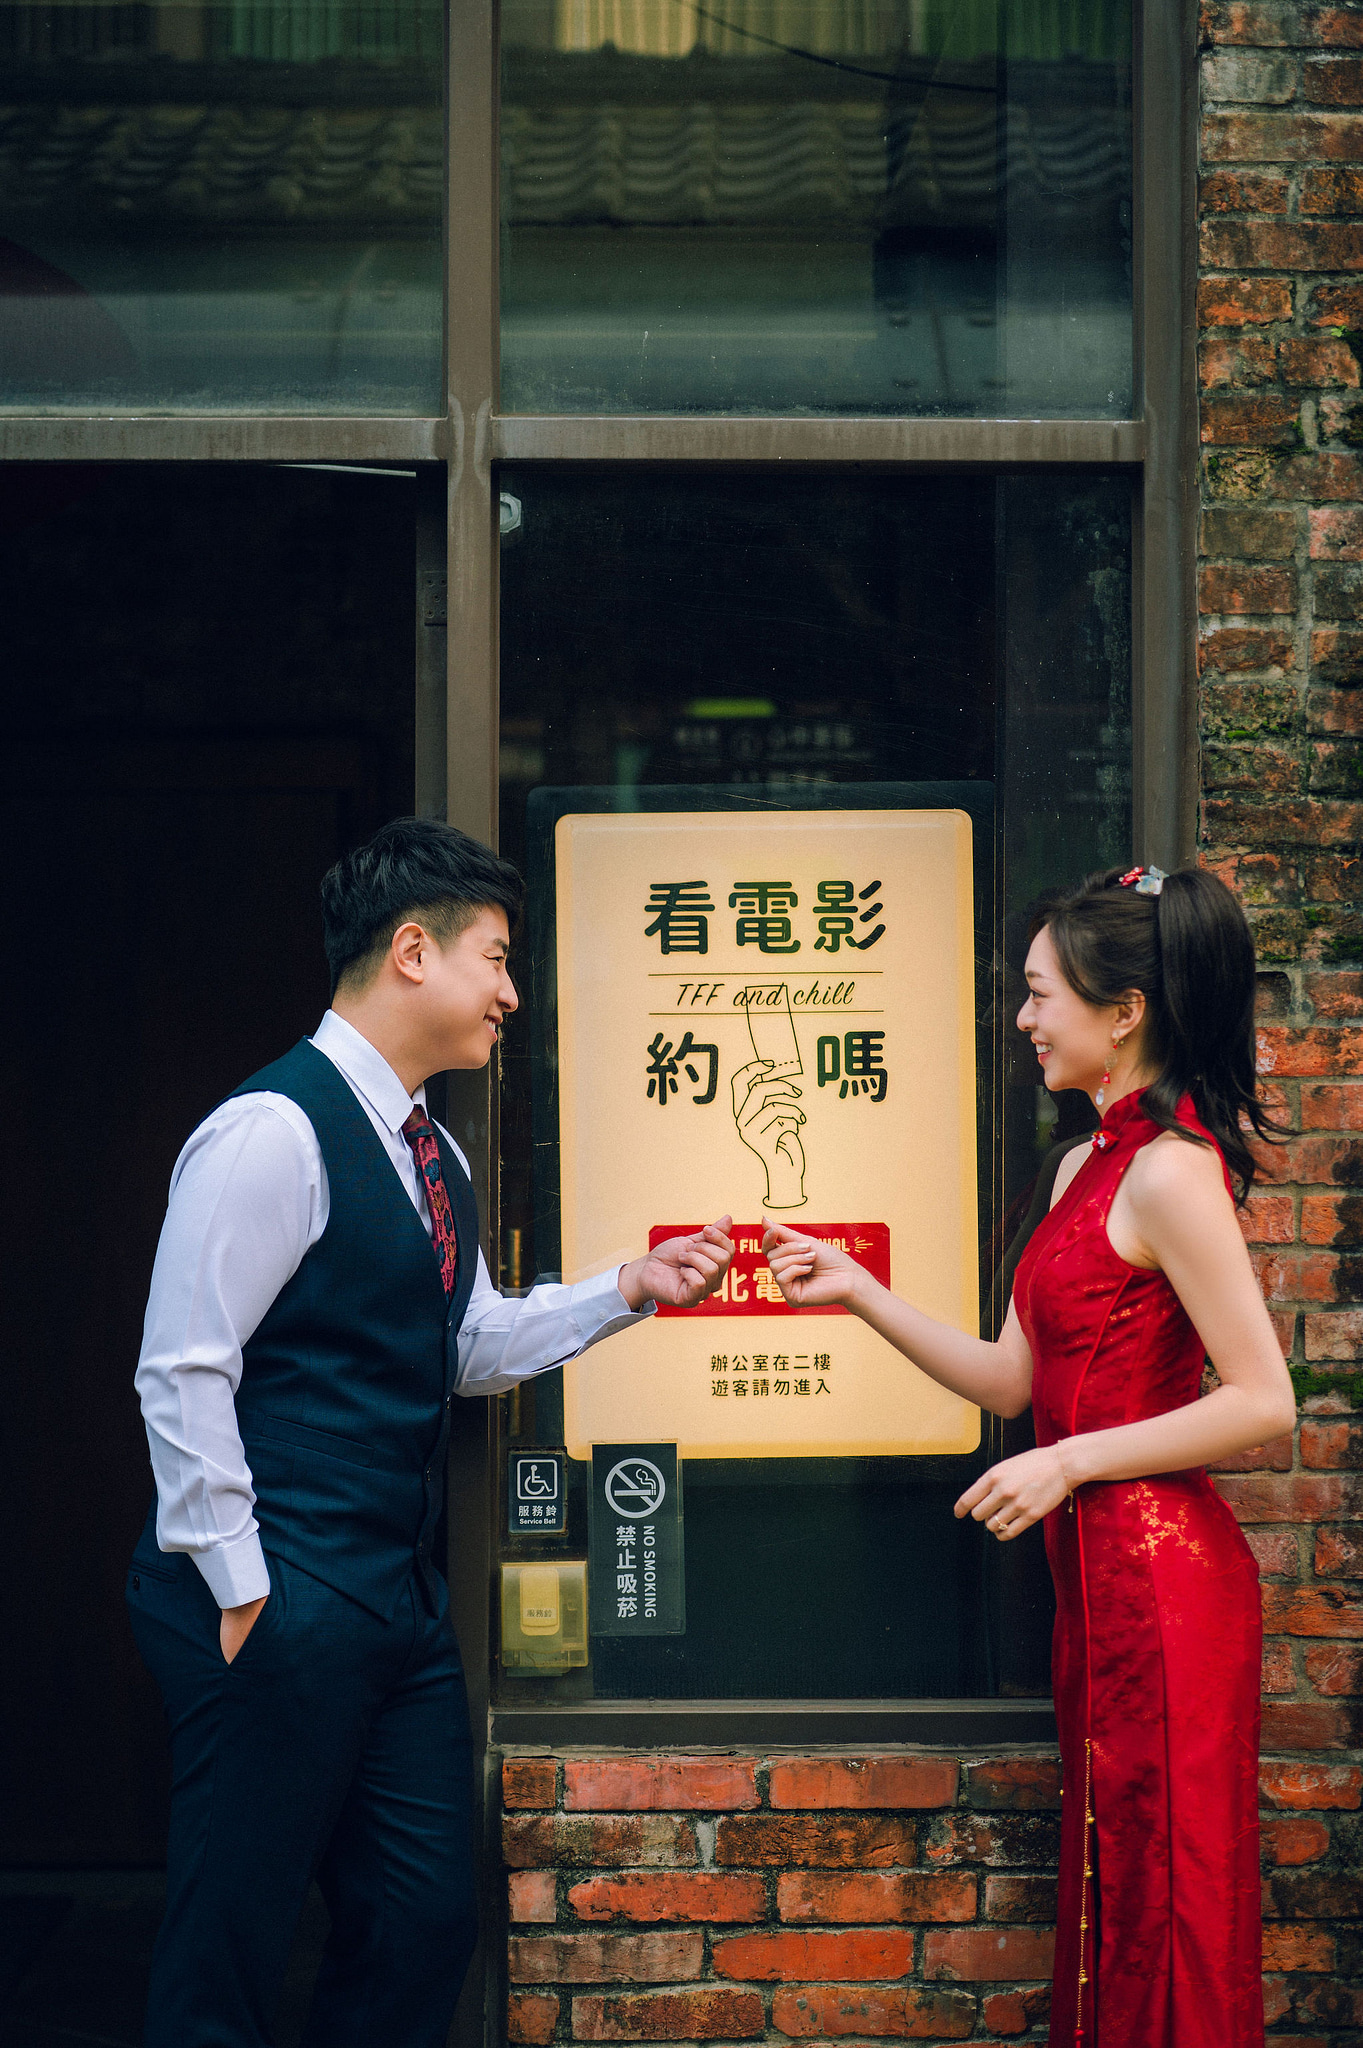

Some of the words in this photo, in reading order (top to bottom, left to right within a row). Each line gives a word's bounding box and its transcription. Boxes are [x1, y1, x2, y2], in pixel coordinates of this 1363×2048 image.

[643, 880, 887, 955] 看電影
[676, 983, 725, 1007] TFF
[732, 982, 783, 1007] and
[792, 980, 856, 1006] chill
[645, 1031, 719, 1106] 約
[816, 1030, 888, 1103] 嗎
[739, 1238, 763, 1253] FIL
[700, 1267, 788, 1303] 北電
[711, 1353, 831, 1372] 辦公室在二樓
[711, 1378, 831, 1397] 遊客請勿進入
[518, 1504, 557, 1517] 服務鈴
[643, 1525, 656, 1547] NO
[615, 1525, 638, 1619] 禁止吸菸
[643, 1550, 657, 1618] SMOKING
